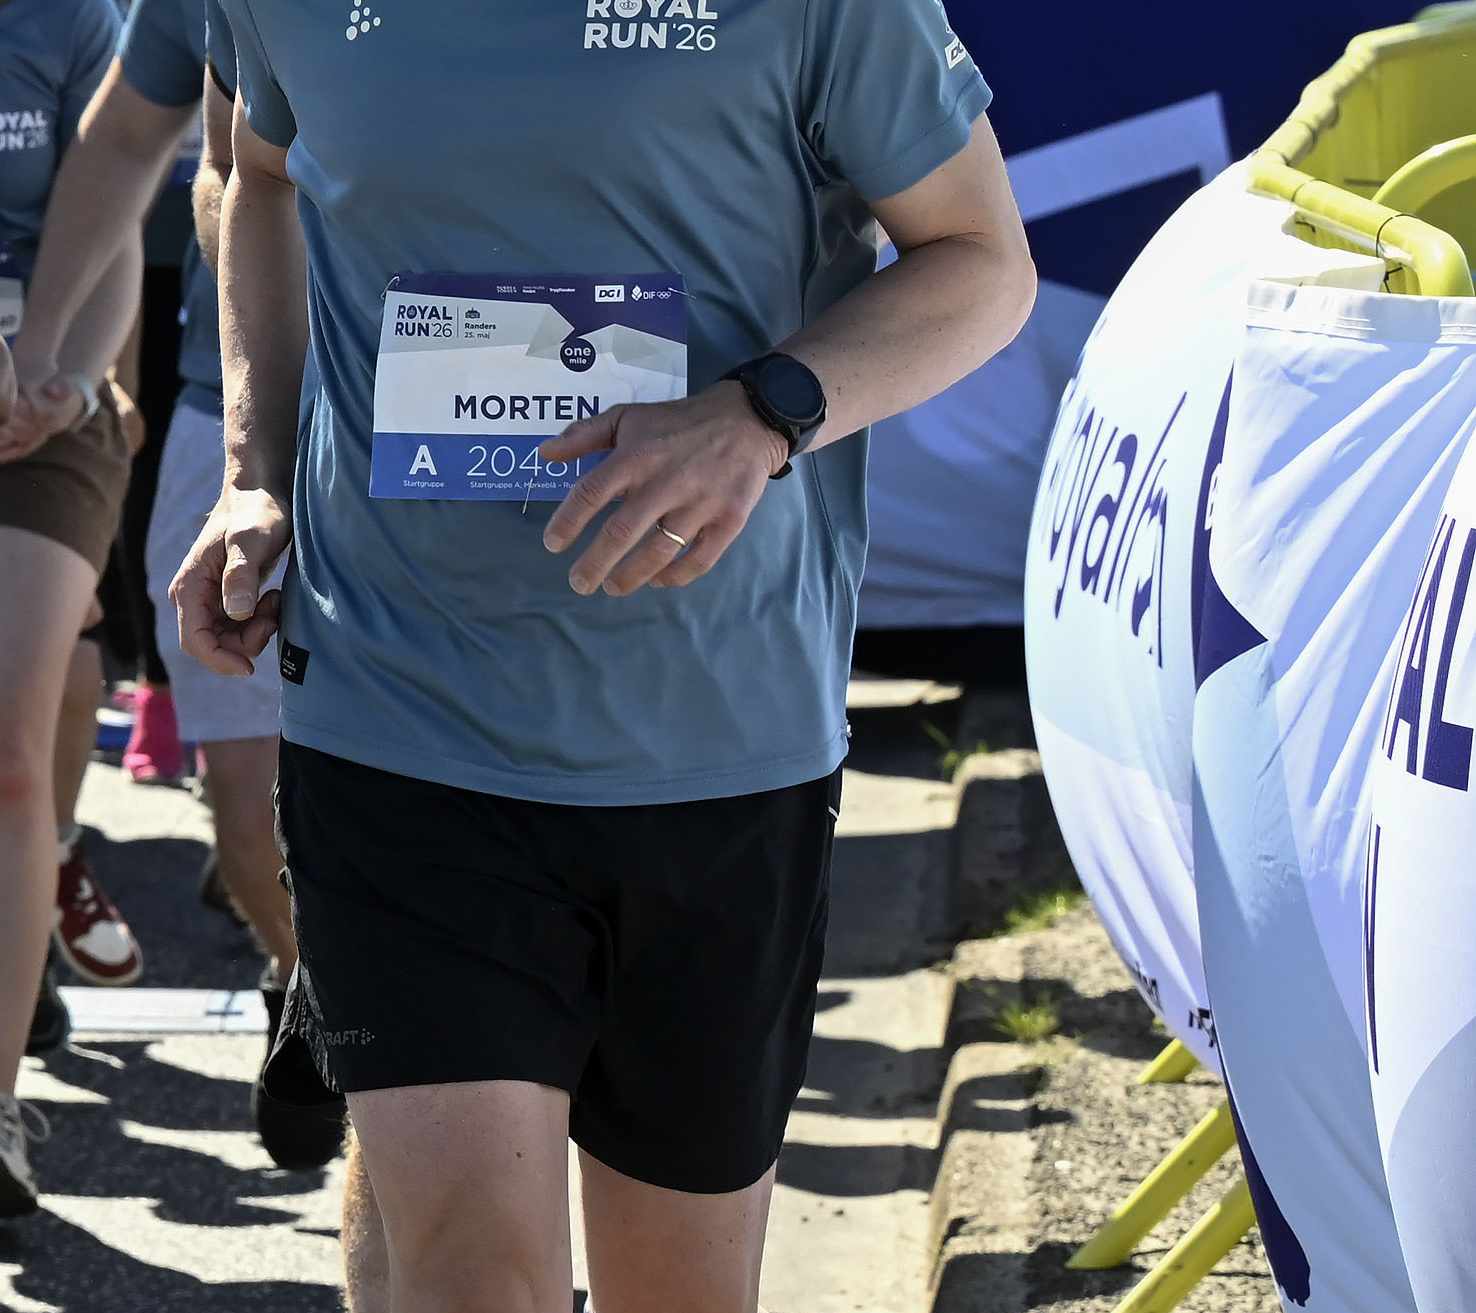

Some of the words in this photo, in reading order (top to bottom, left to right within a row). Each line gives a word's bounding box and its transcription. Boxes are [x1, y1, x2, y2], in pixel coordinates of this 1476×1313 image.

[597, 288, 621, 299] DGI
[396, 304, 453, 320] ROYAL
[464, 322, 497, 331] Randers
[564, 345, 592, 357] one
[569, 357, 587, 365] mile
[454, 394, 600, 421] MORTEN
[408, 444, 438, 476] A
[403, 479, 445, 489] Startgruppe
[469, 481, 513, 490] Startgruppe
